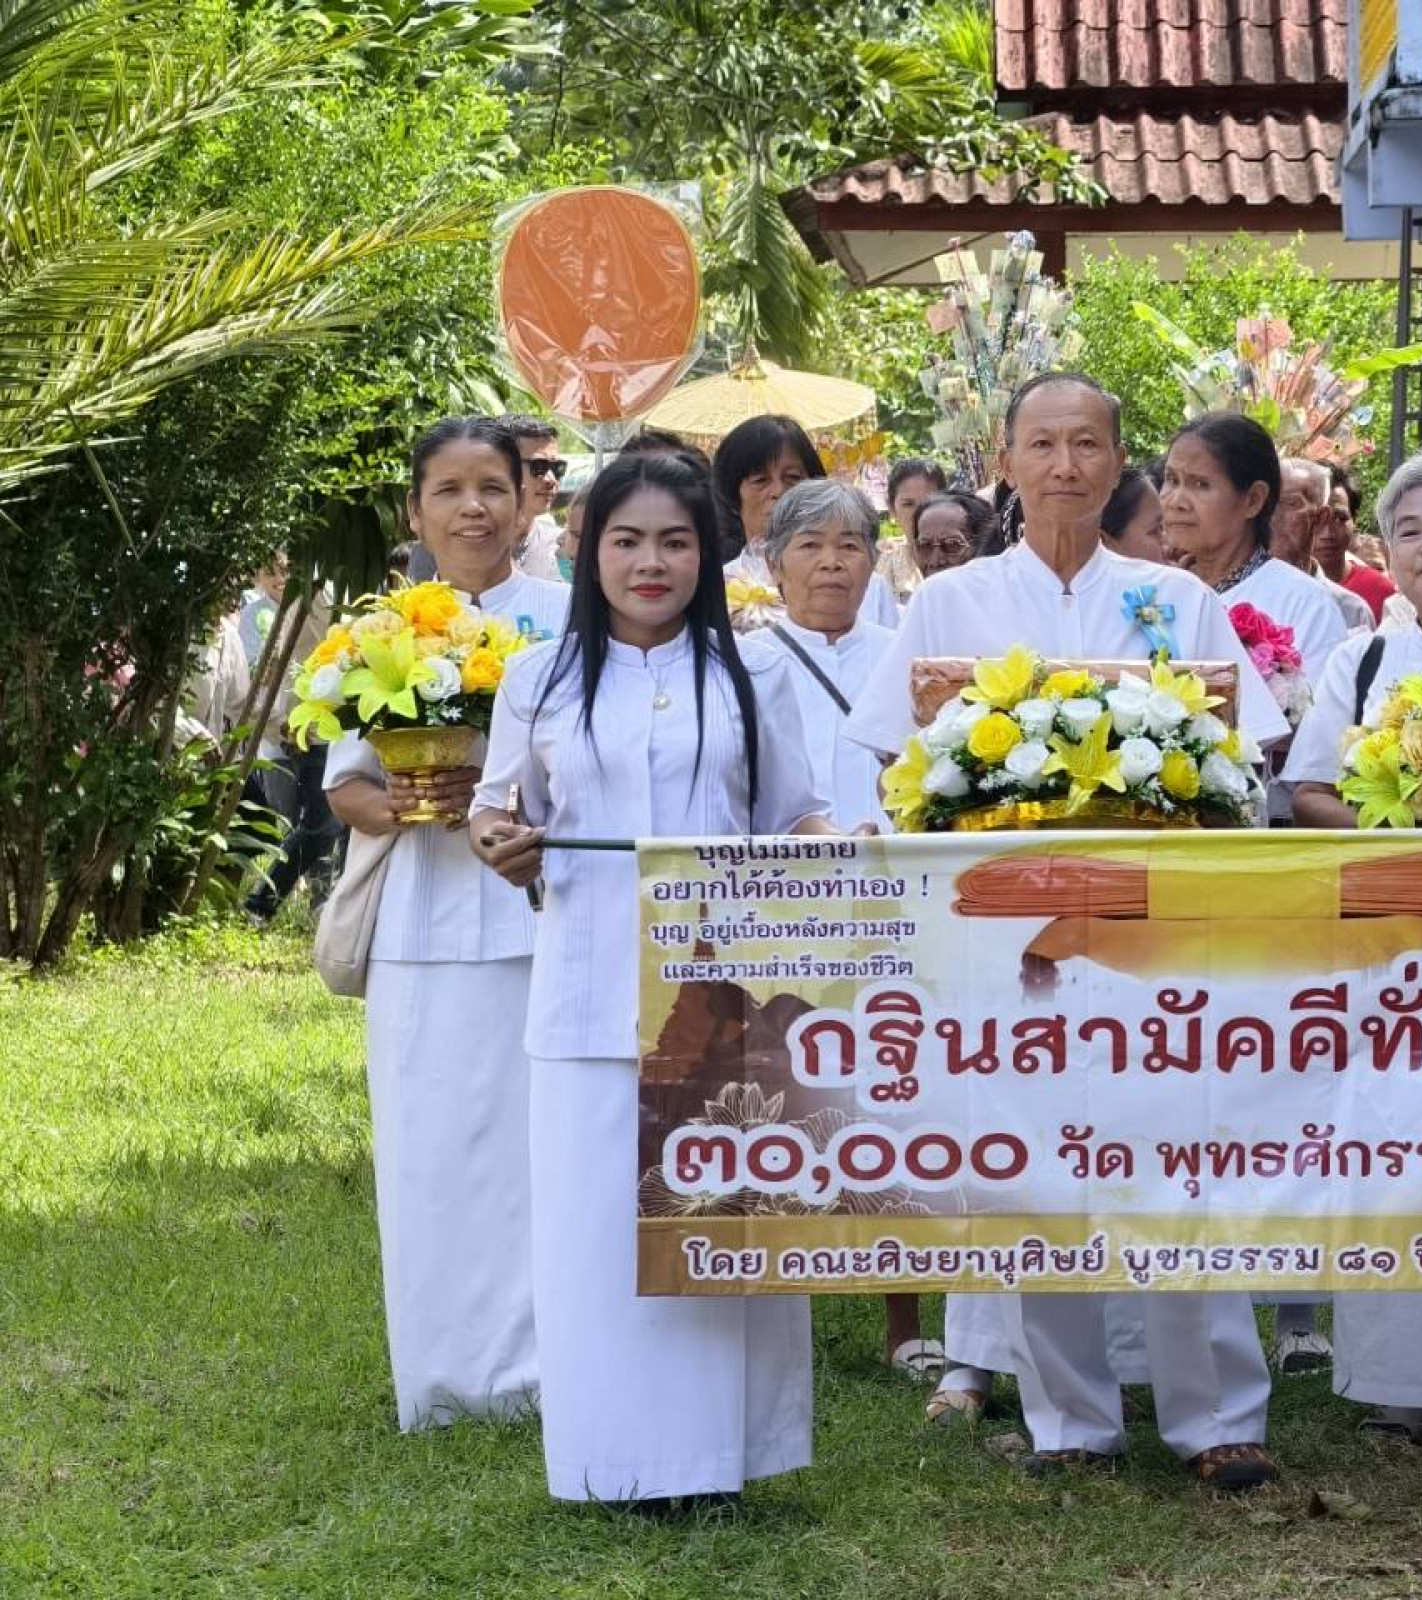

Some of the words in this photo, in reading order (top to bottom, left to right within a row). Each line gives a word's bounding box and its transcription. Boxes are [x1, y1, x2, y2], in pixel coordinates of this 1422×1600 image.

[653, 868, 906, 901] อยากได้ต้องทำเอง
[651, 922, 690, 943] บุญ
[701, 911, 916, 946] อยู่เบื้องหลังความสุข
[674, 1132, 1029, 1195] ๓๐,๐๐๐
[1057, 1125, 1134, 1179] วัด
[686, 1241, 763, 1277] โดย
[783, 1234, 1106, 1285] คณะศิษยานุศิษย์
[1124, 1244, 1320, 1284] บูชาธรรม
[1336, 1247, 1397, 1273] ๘๑
